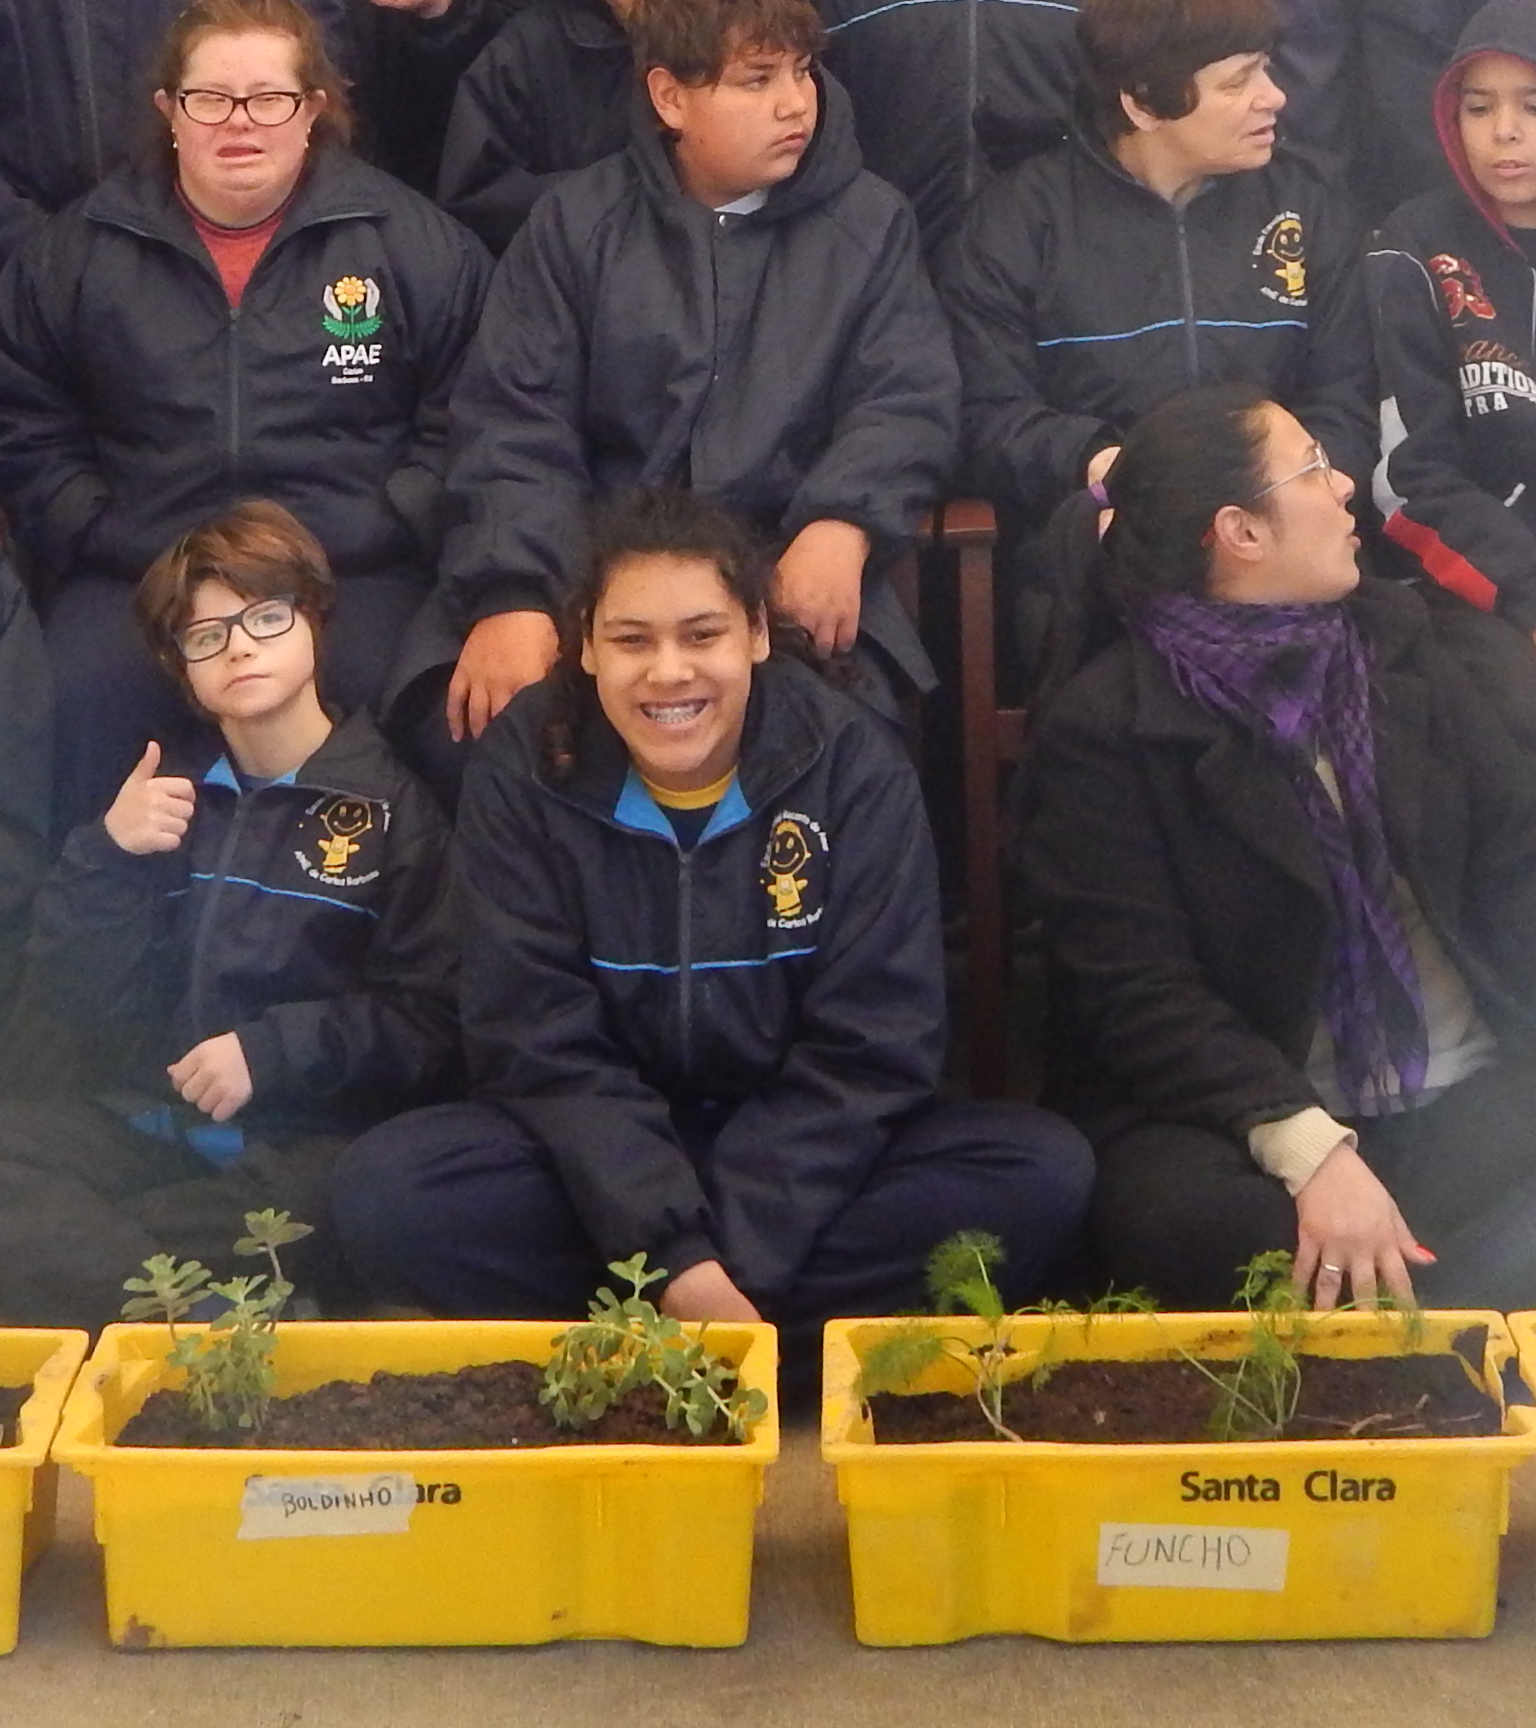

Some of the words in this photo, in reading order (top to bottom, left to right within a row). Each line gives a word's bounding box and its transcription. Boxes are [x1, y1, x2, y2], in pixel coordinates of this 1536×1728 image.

[322, 344, 383, 366] APAE
[282, 1486, 392, 1518] BOLDINHO
[1180, 1471, 1281, 1502] Santa
[1304, 1470, 1396, 1502] Clara
[1105, 1532, 1251, 1571] FUNCHO
